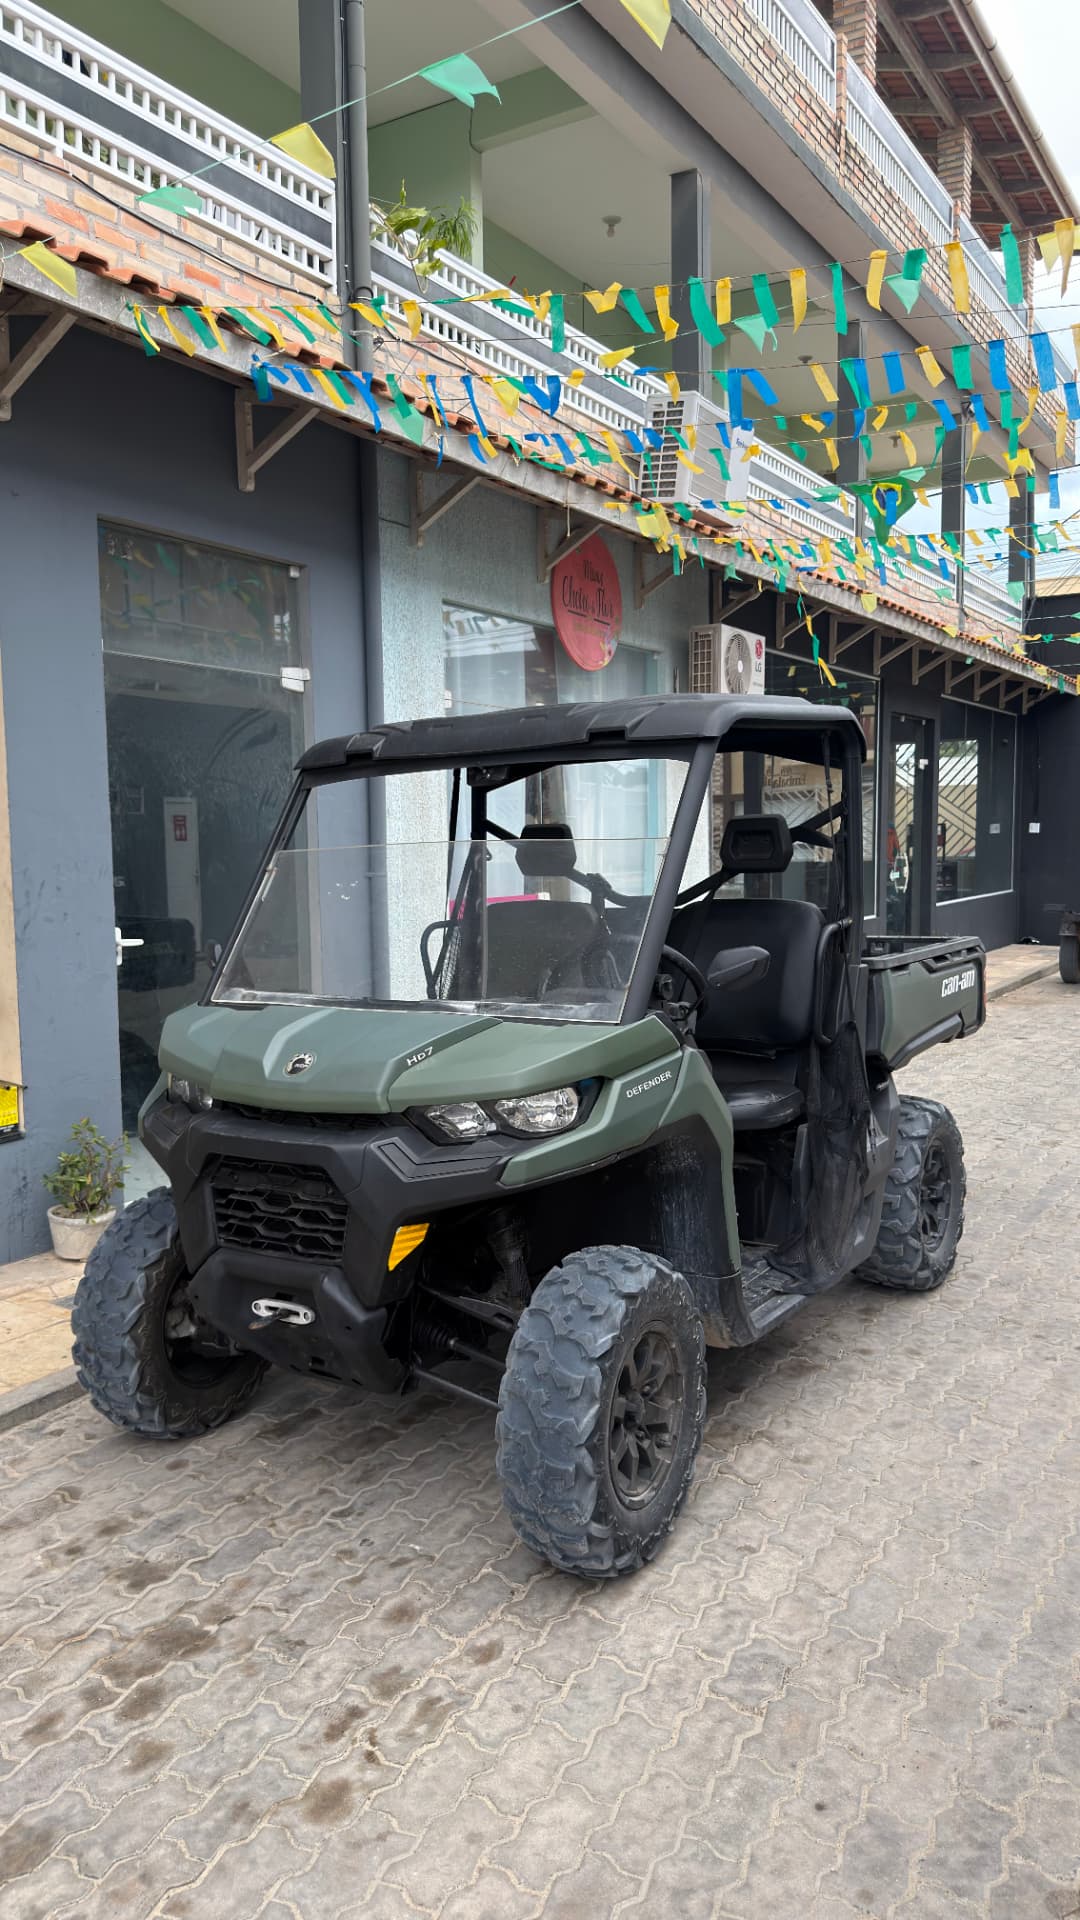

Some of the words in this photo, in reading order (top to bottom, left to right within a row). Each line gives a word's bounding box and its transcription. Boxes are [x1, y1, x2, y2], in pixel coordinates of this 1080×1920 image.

[755, 662, 762, 672] LG
[406, 1046, 433, 1066] HD7
[626, 1070, 672, 1098] DEFENDER
